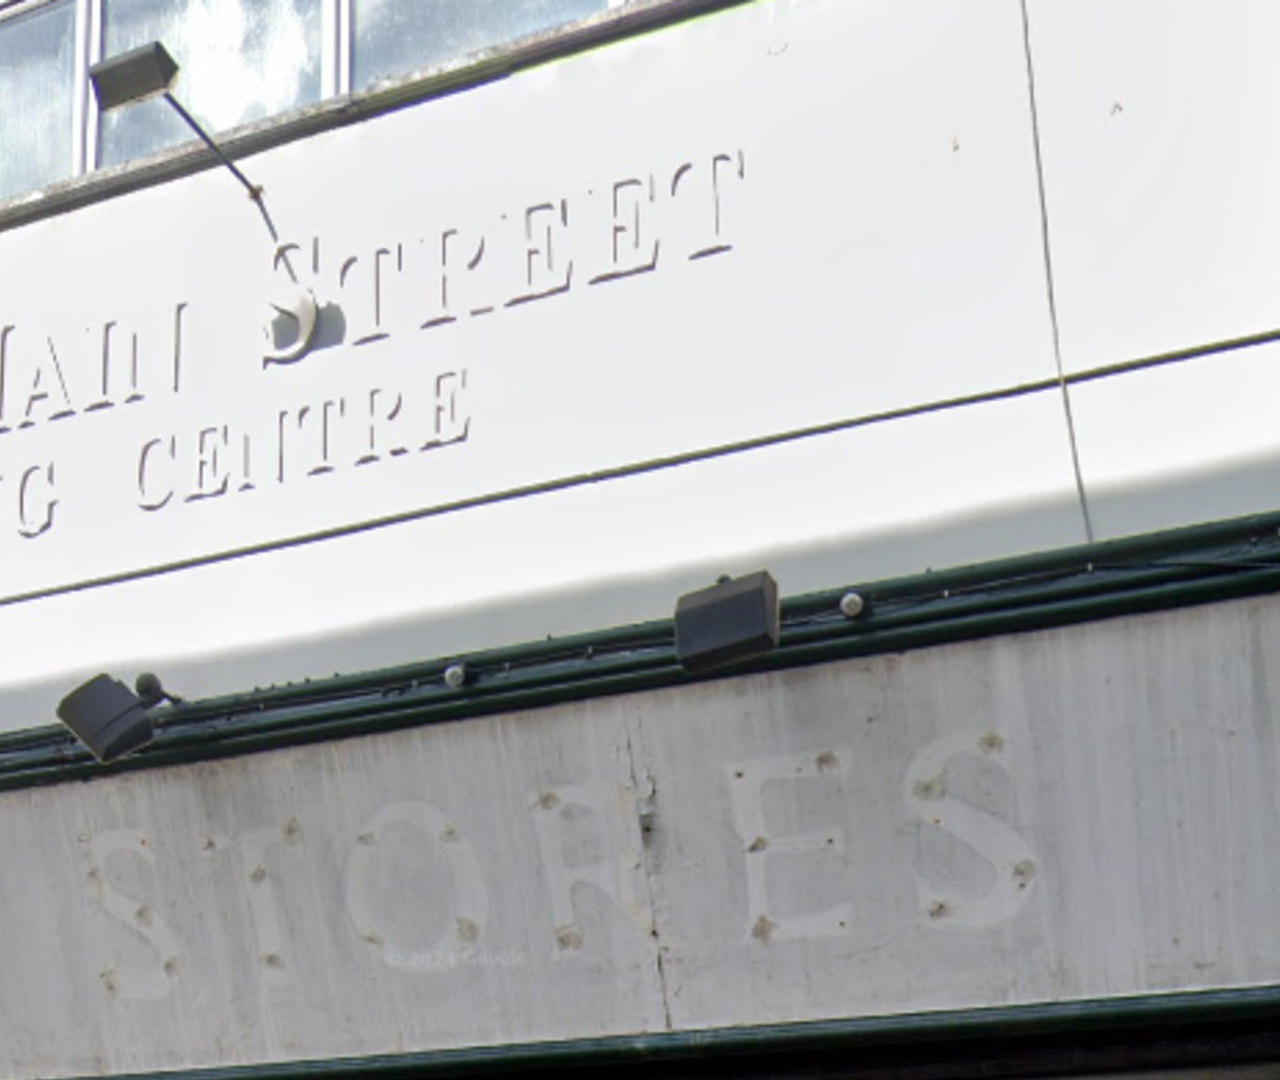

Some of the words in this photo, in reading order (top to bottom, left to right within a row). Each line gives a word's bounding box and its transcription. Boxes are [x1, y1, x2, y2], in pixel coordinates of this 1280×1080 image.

[263, 150, 747, 370] STREET
[137, 367, 472, 512] CENTRE
[83, 728, 1038, 1000] STORES
